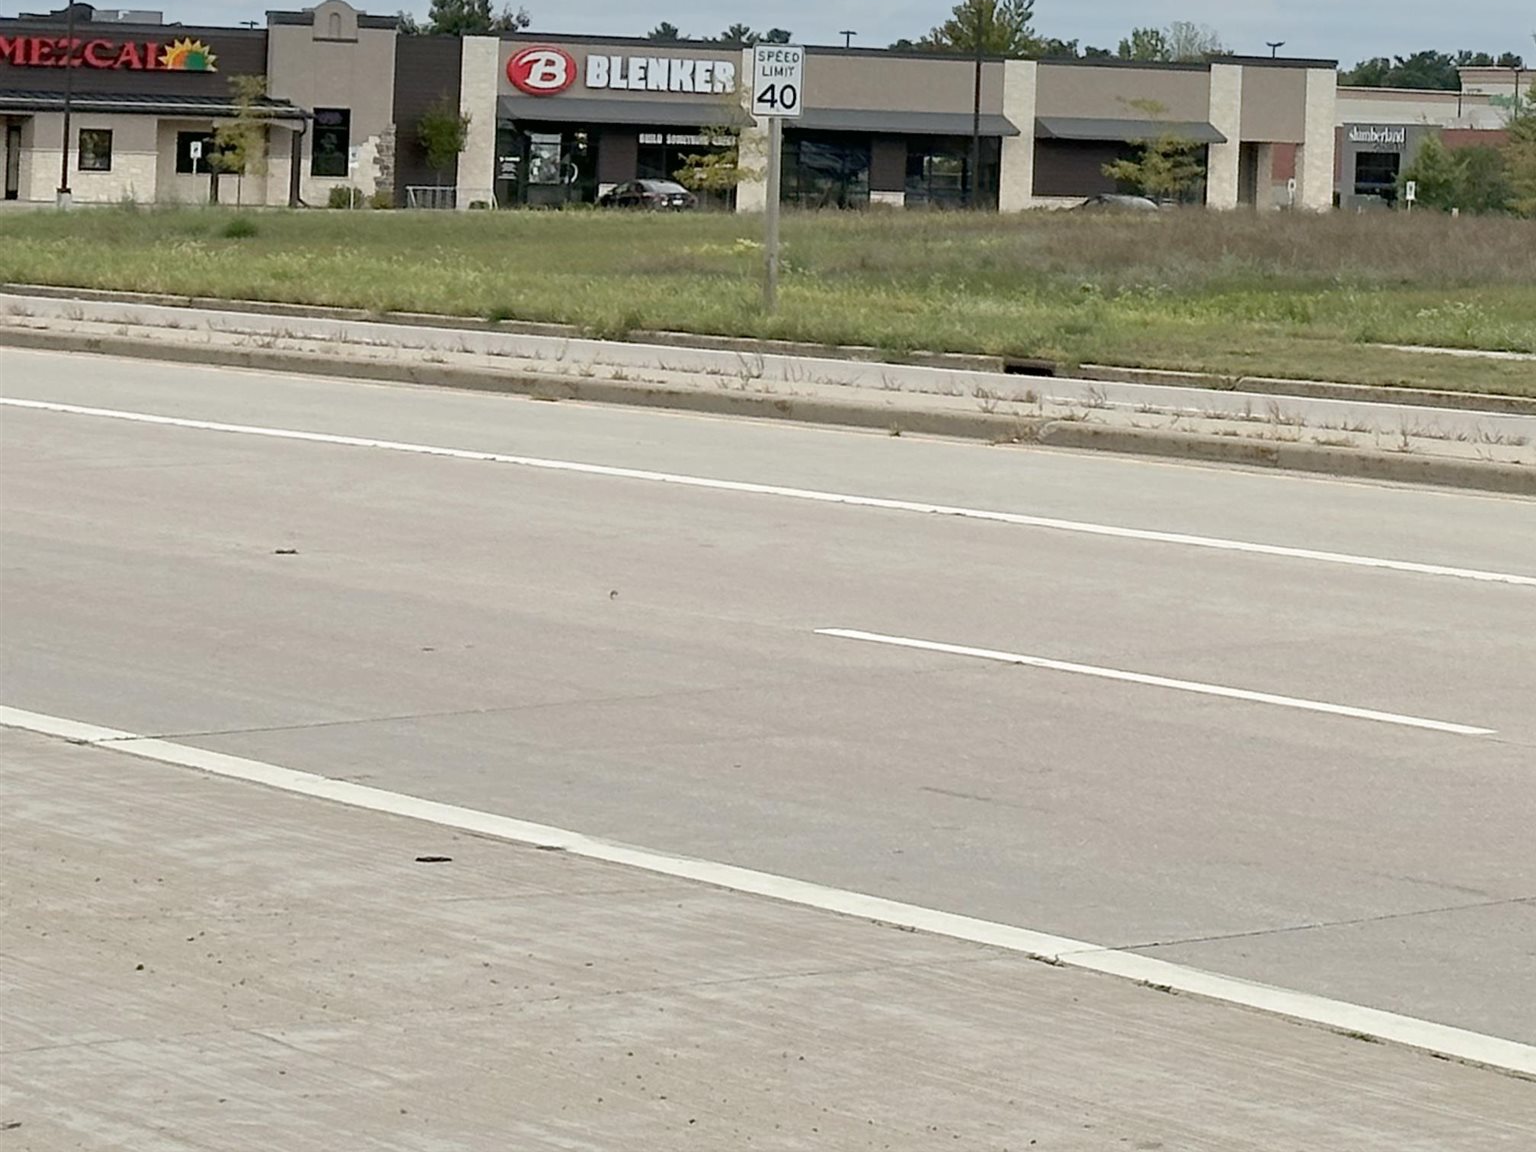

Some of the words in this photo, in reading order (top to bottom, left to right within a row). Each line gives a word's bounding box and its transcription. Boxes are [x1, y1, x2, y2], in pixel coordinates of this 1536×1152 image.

[0, 34, 168, 70] MEZCAL
[758, 50, 800, 63] SPEED
[586, 54, 736, 94] BLENKER
[762, 65, 795, 77] LIMIT
[757, 83, 797, 110] 40
